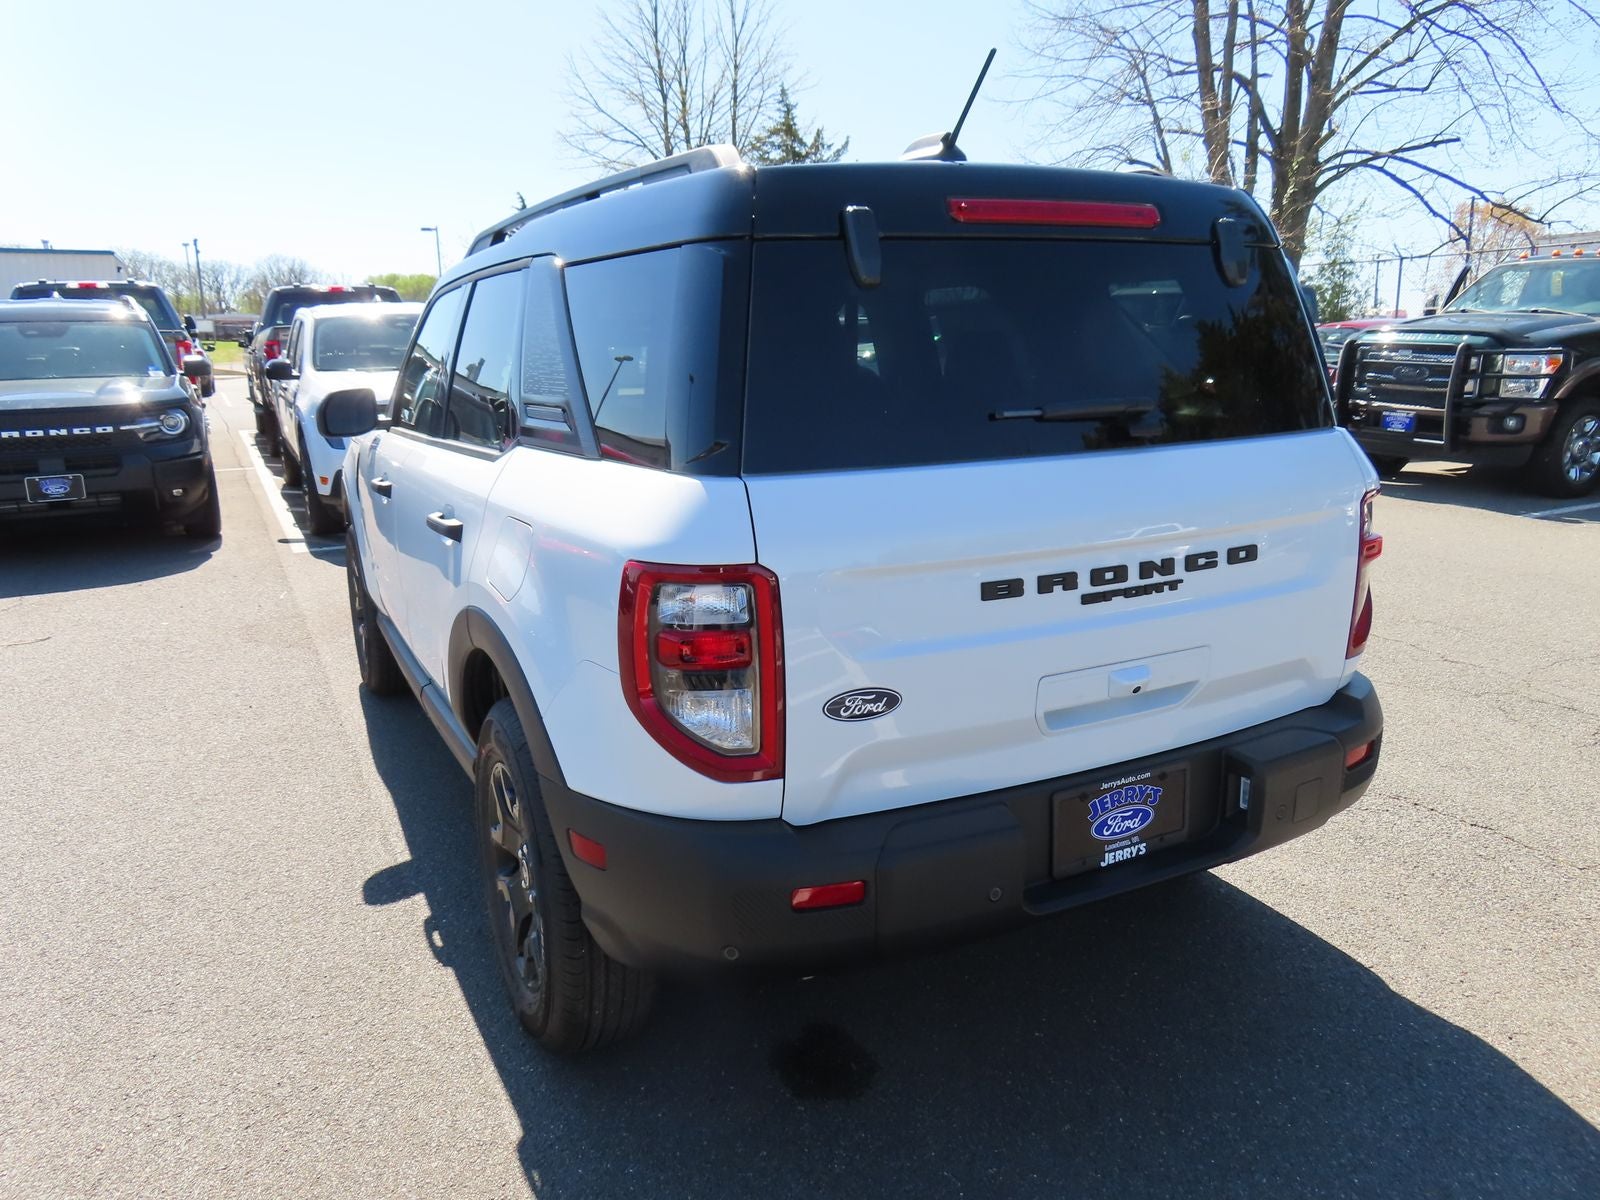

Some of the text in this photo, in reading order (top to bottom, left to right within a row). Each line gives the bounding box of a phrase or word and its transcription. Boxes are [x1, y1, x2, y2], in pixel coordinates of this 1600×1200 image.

[980, 544, 1258, 601] BRONCO
[1081, 579, 1183, 605] SPORT
[840, 694, 888, 716] Ford
[1100, 772, 1151, 790] JerrysAuto.com
[1103, 811, 1141, 836] Ford
[1100, 843, 1147, 867] JERRY'S
